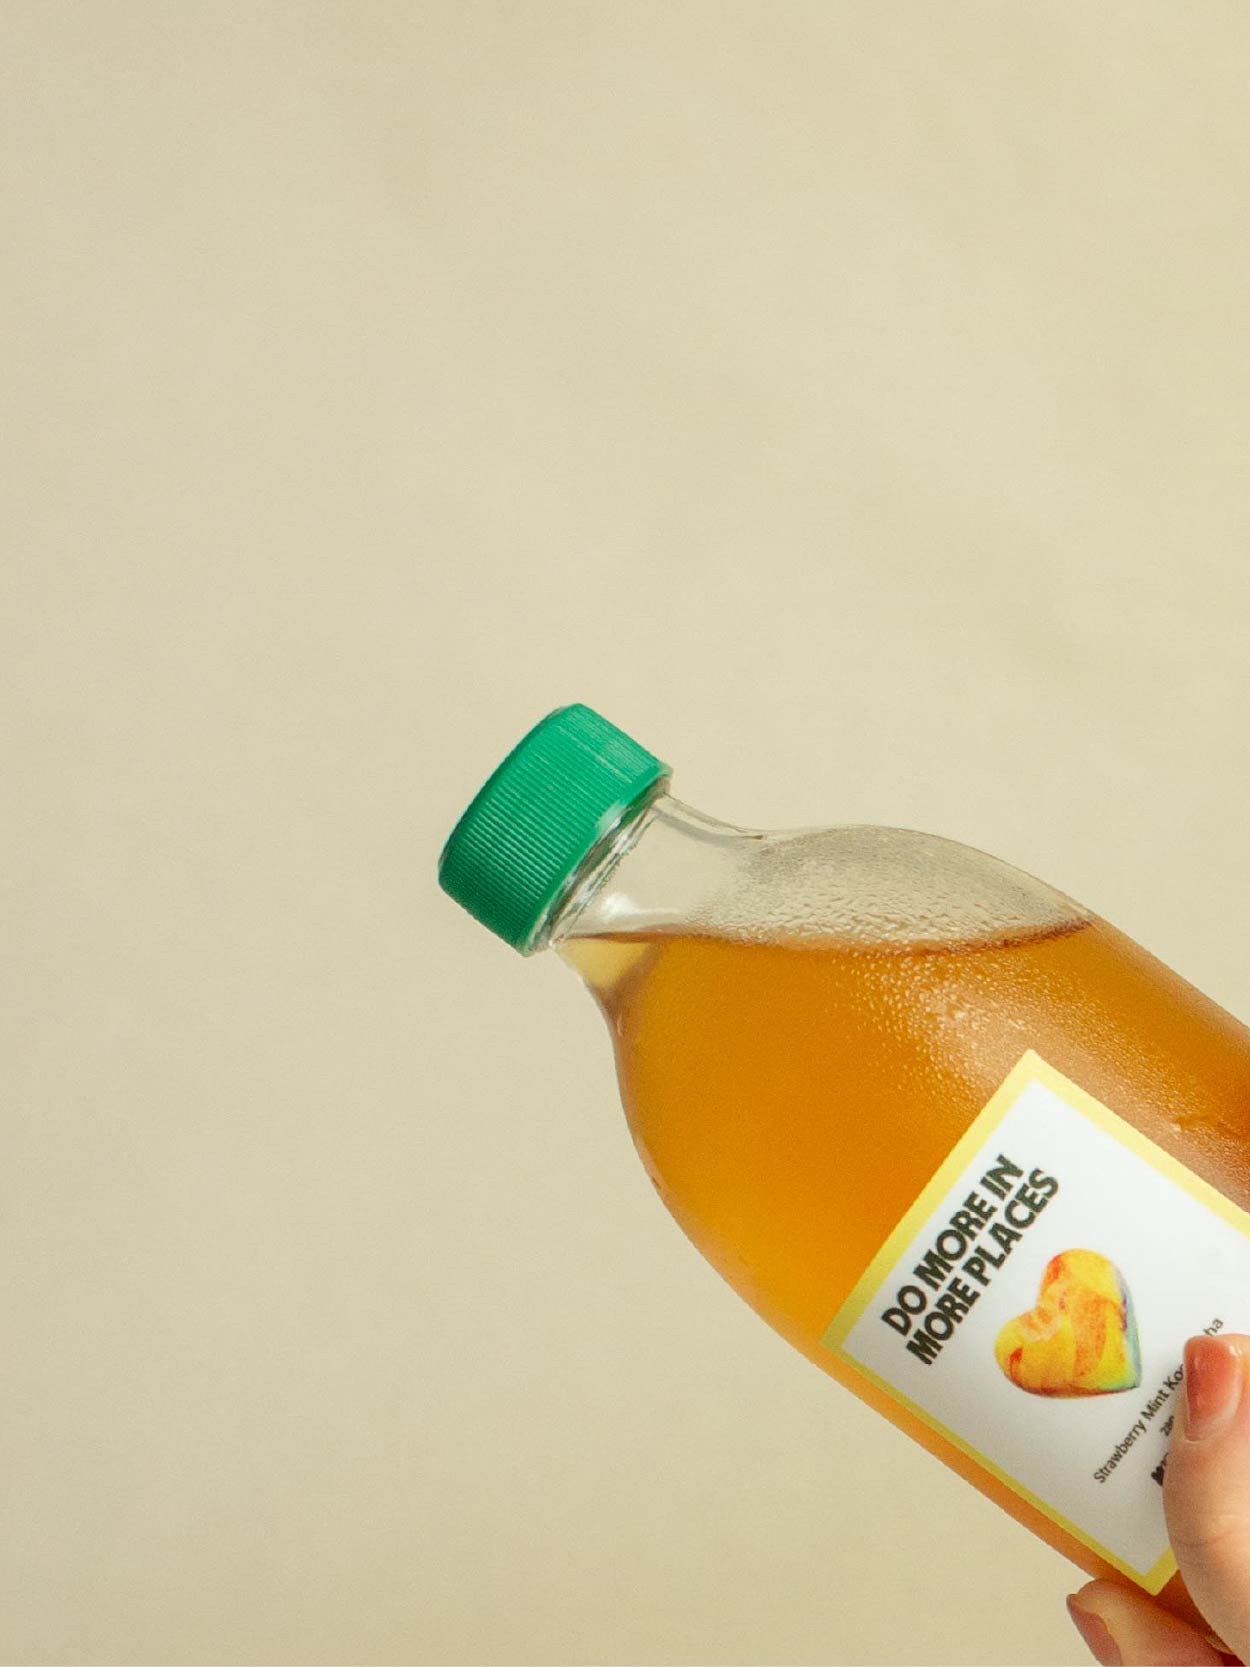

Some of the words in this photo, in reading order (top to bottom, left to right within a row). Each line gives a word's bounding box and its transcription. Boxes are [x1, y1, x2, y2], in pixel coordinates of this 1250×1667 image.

[881, 1285, 927, 1337] DO
[913, 1191, 998, 1292] MORE
[979, 1153, 1024, 1201] IN
[906, 1277, 981, 1366] MORE
[962, 1168, 1059, 1287] PLACES
[1094, 1419, 1148, 1483] Strawberry
[1140, 1389, 1170, 1422] Mint
